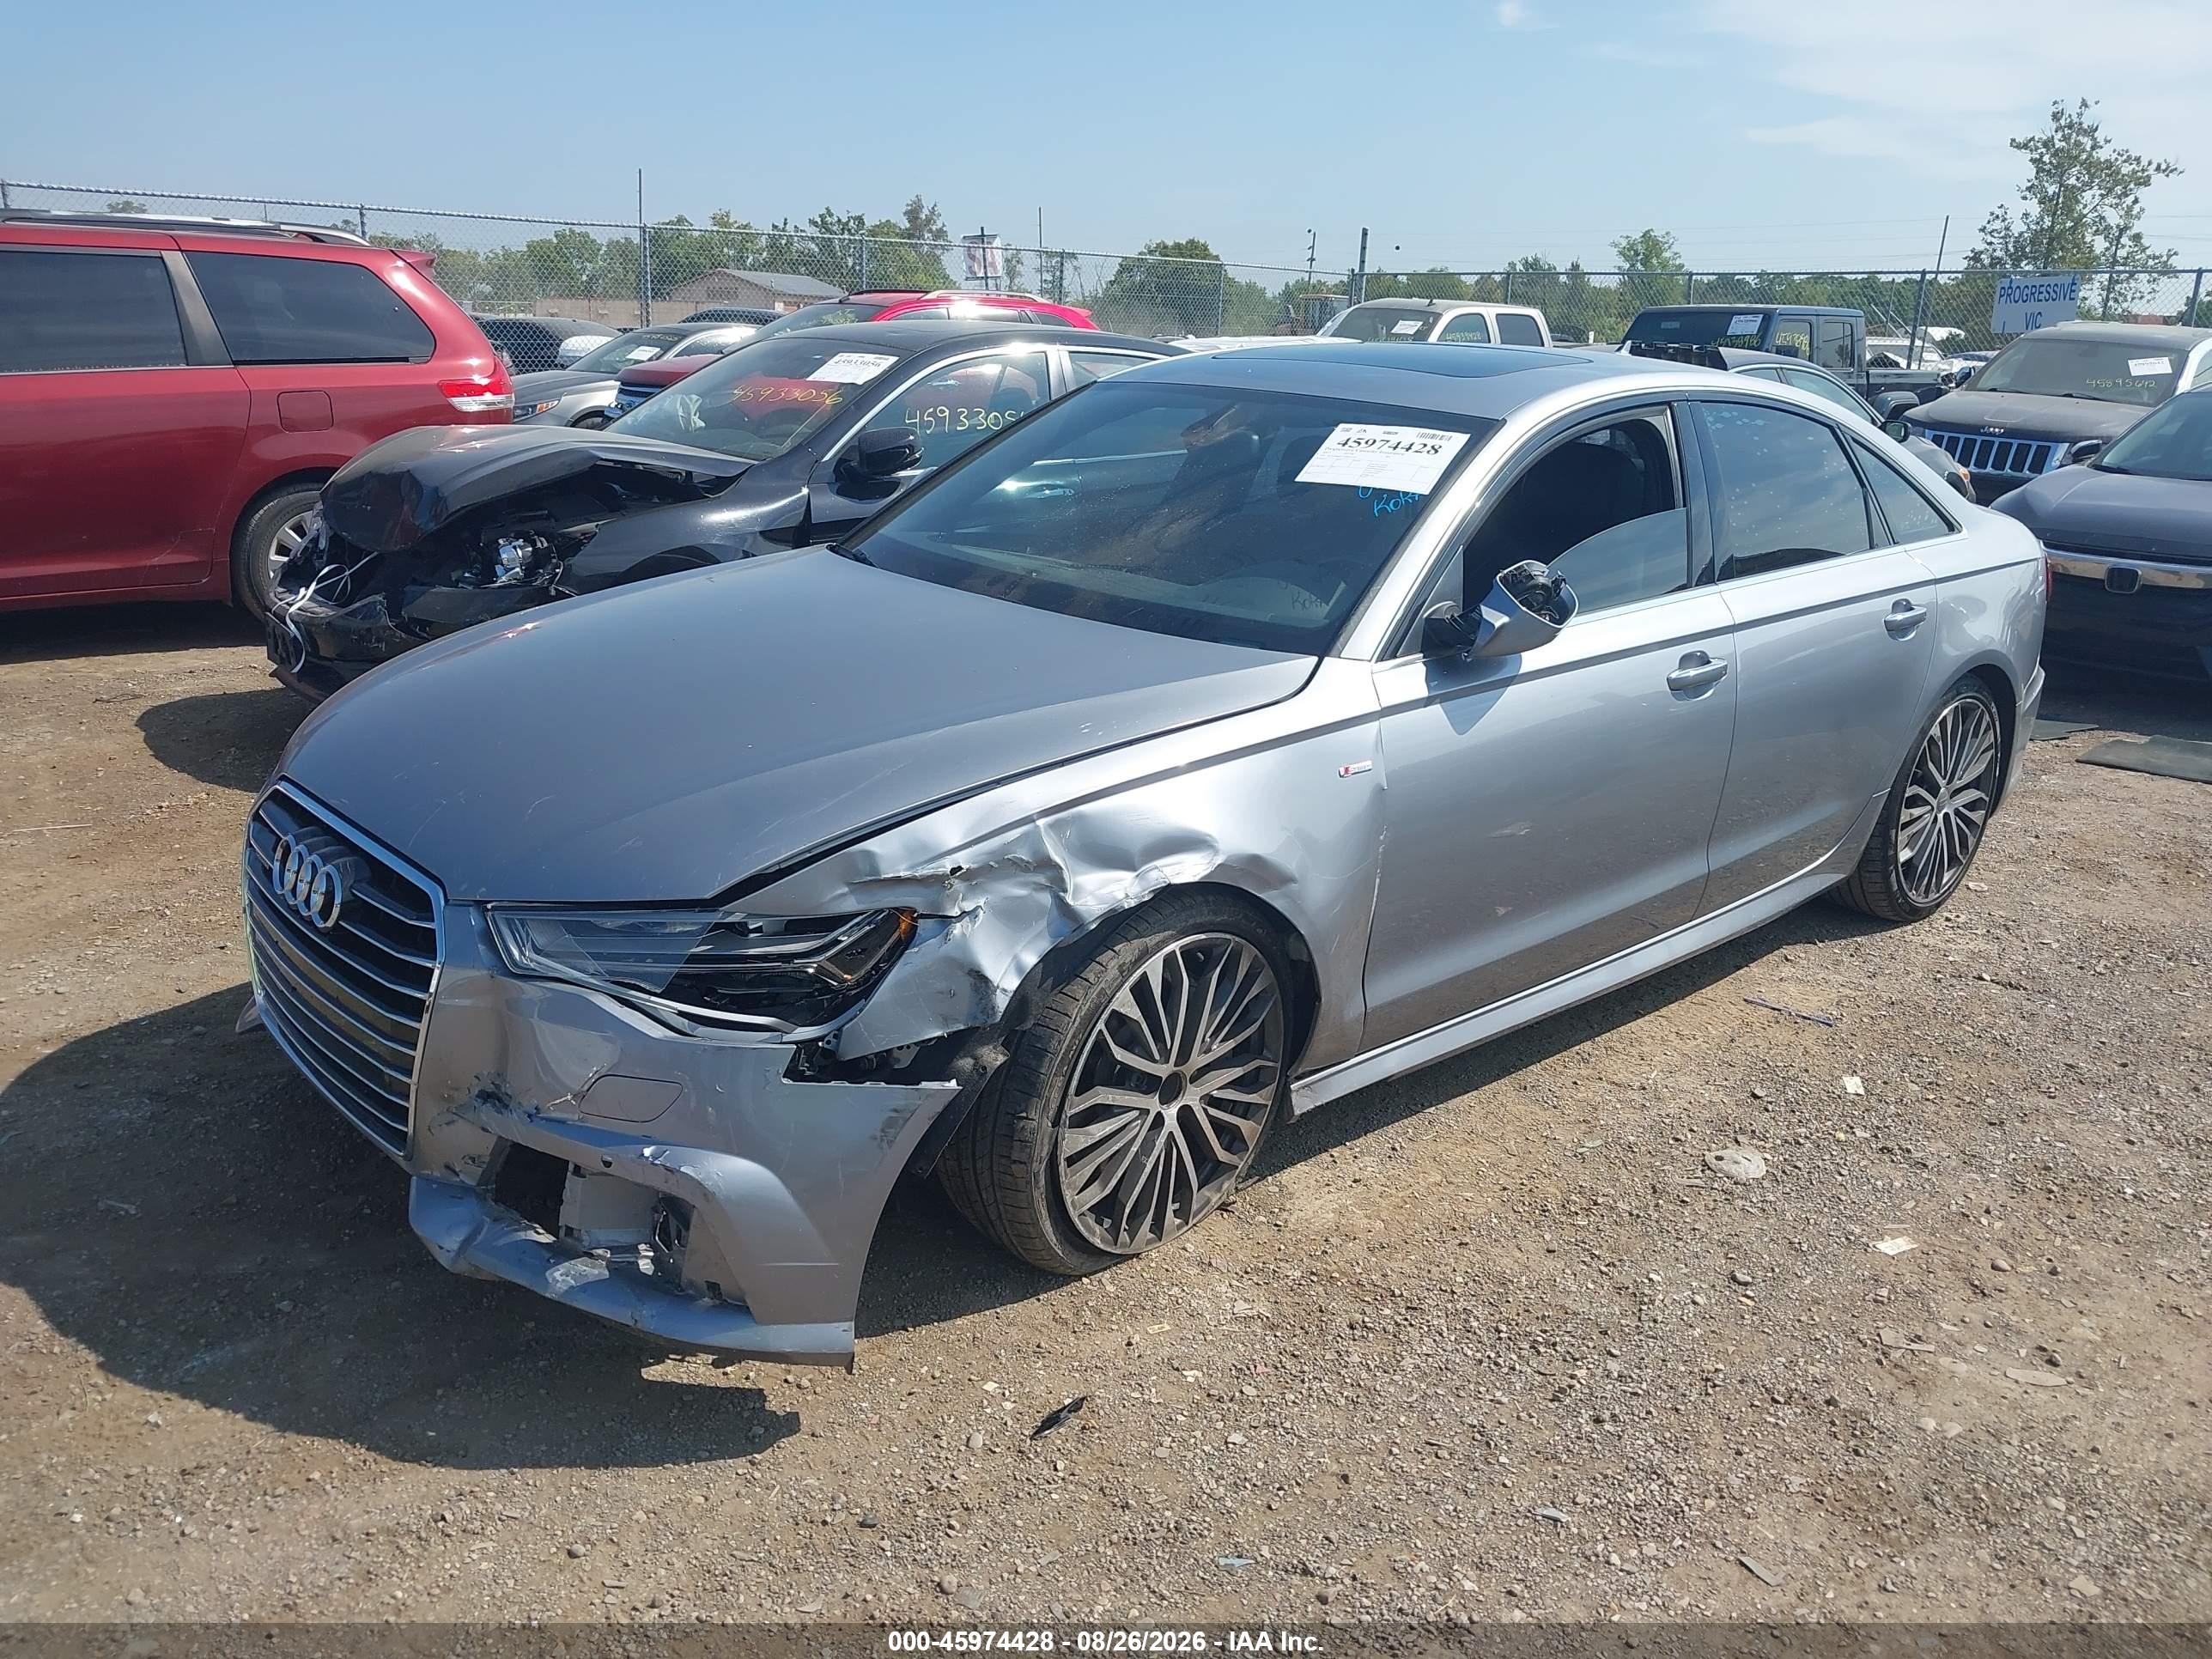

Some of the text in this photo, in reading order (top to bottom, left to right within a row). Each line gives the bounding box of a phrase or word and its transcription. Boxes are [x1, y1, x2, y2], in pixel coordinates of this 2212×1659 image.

[1998, 282, 2077, 304] PROGRESSIVE
[2025, 312, 2042, 330] VIC
[733, 385, 842, 404] 45933056
[905, 406, 1024, 437] 4593305
[1337, 436, 1443, 456] 45974428
